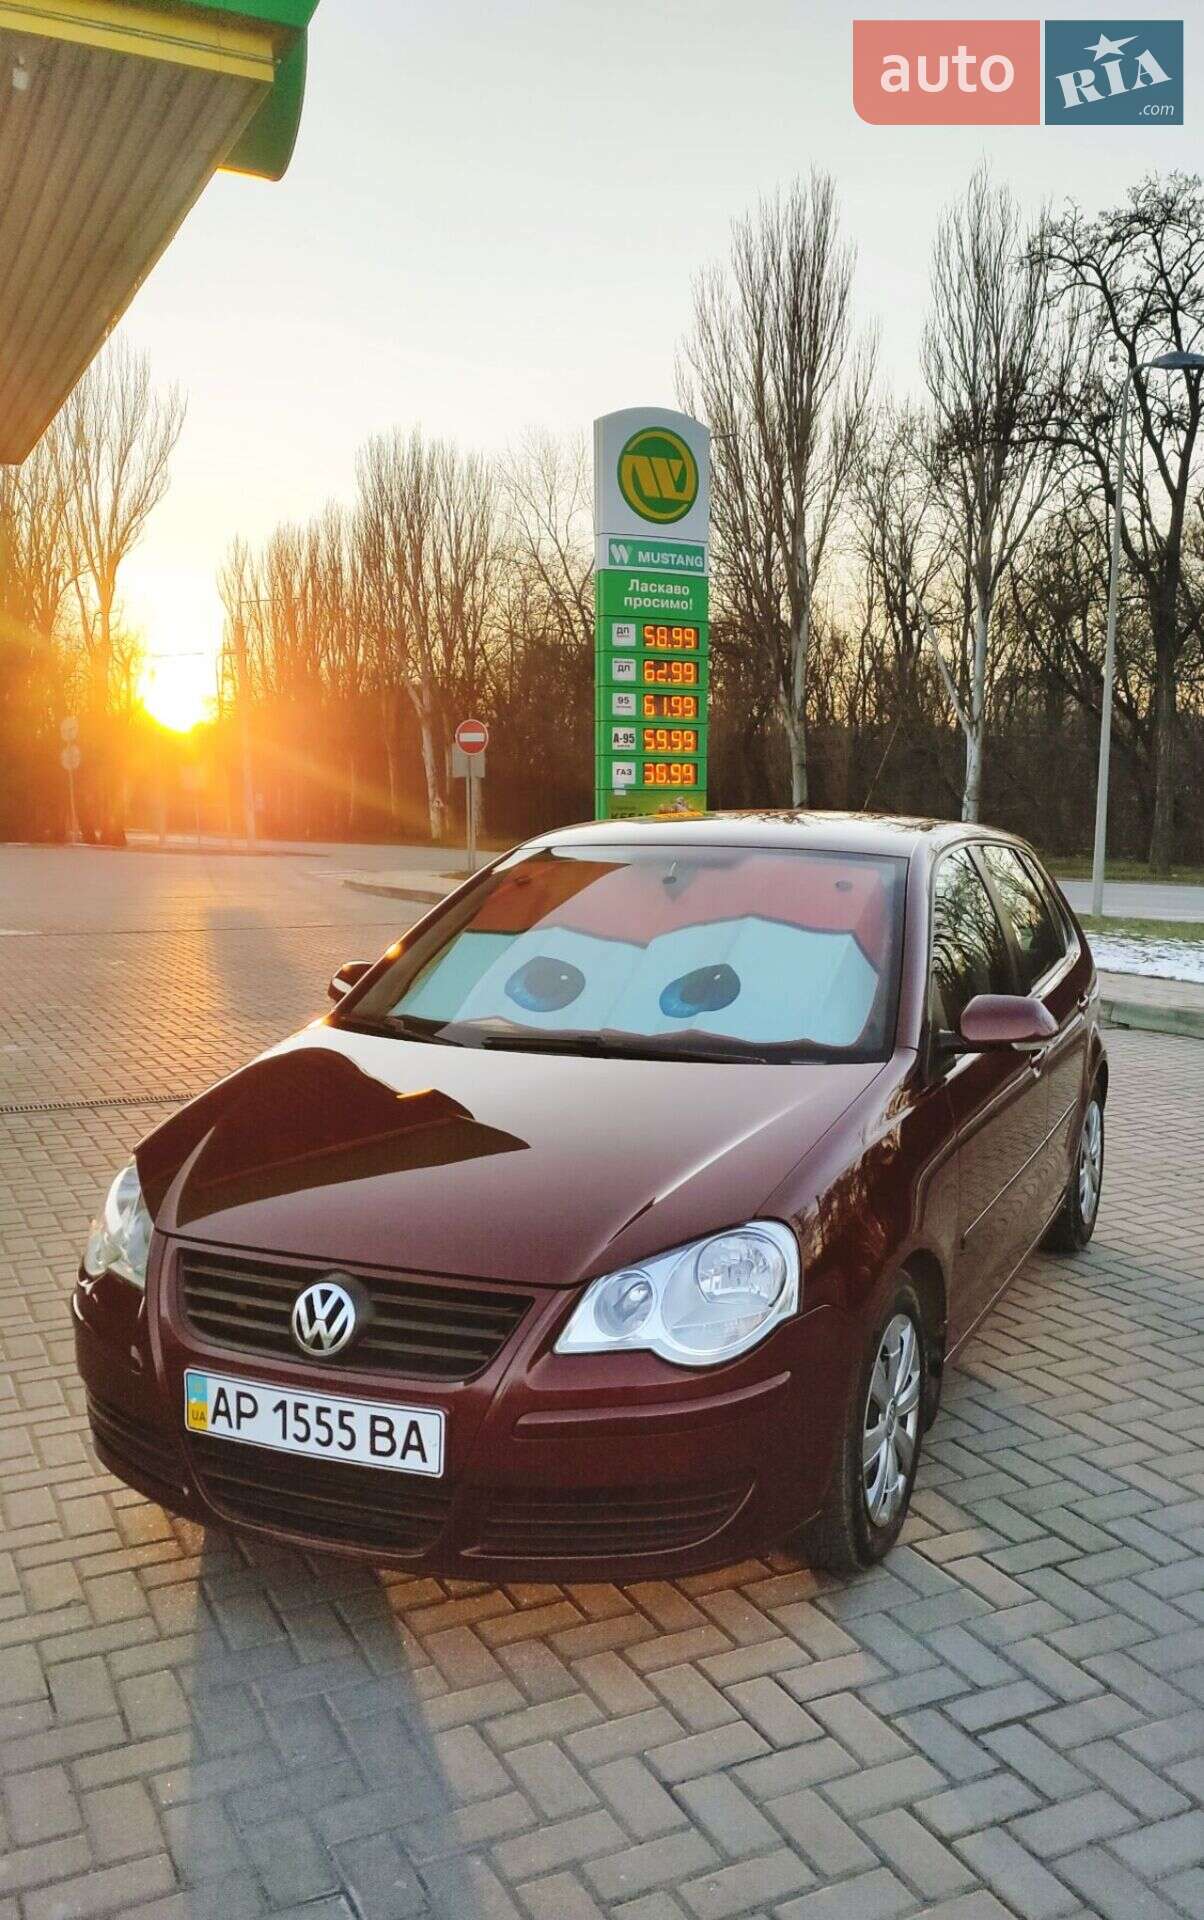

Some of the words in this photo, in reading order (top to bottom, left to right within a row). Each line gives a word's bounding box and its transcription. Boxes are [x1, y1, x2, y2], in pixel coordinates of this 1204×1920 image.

[638, 551, 704, 568] MUSTANG
[628, 579, 690, 596] Ласкаво
[624, 596, 694, 610] просимо!
[644, 660, 695, 683] 62.99
[617, 696, 630, 705] 95
[644, 695, 694, 717] 61.99
[644, 729, 695, 751] 59.99
[616, 768, 633, 776] ГАЗ
[191, 1408, 207, 1423] UA
[211, 1386, 259, 1431] AP
[272, 1399, 357, 1452] 1555
[369, 1413, 429, 1464] BA
